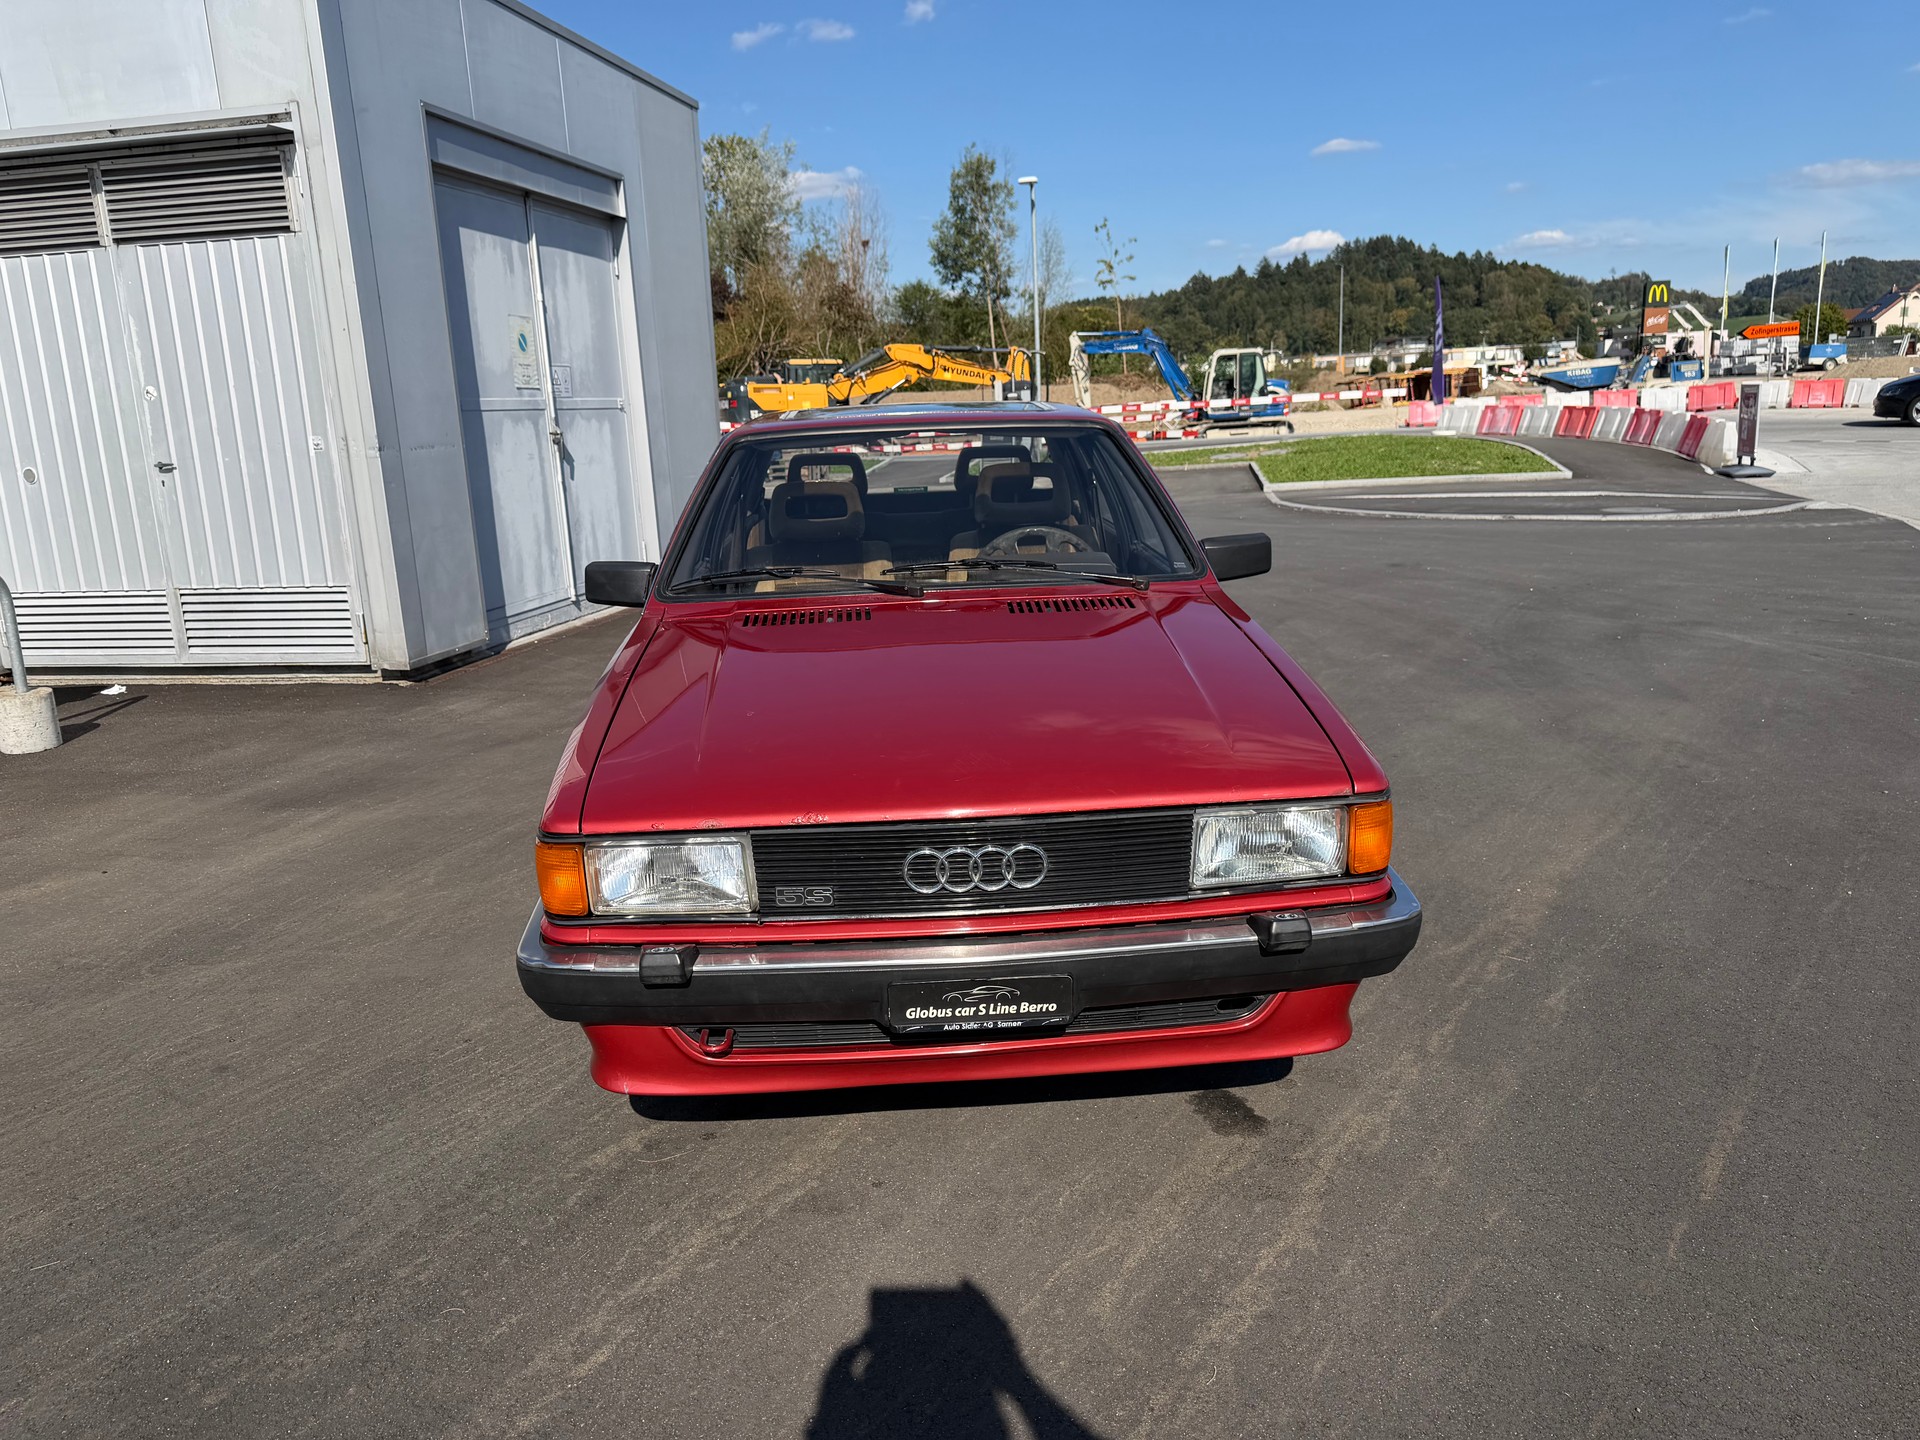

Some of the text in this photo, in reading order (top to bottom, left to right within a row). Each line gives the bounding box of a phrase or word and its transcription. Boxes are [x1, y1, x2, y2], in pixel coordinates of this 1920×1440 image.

[1750, 325, 1798, 335] Zofingerstrasse
[945, 366, 985, 379] HYUNDAI
[776, 886, 833, 906] 5S
[905, 1001, 1057, 1019] Globus car S Line Berro
[943, 1023, 960, 1031] Auto
